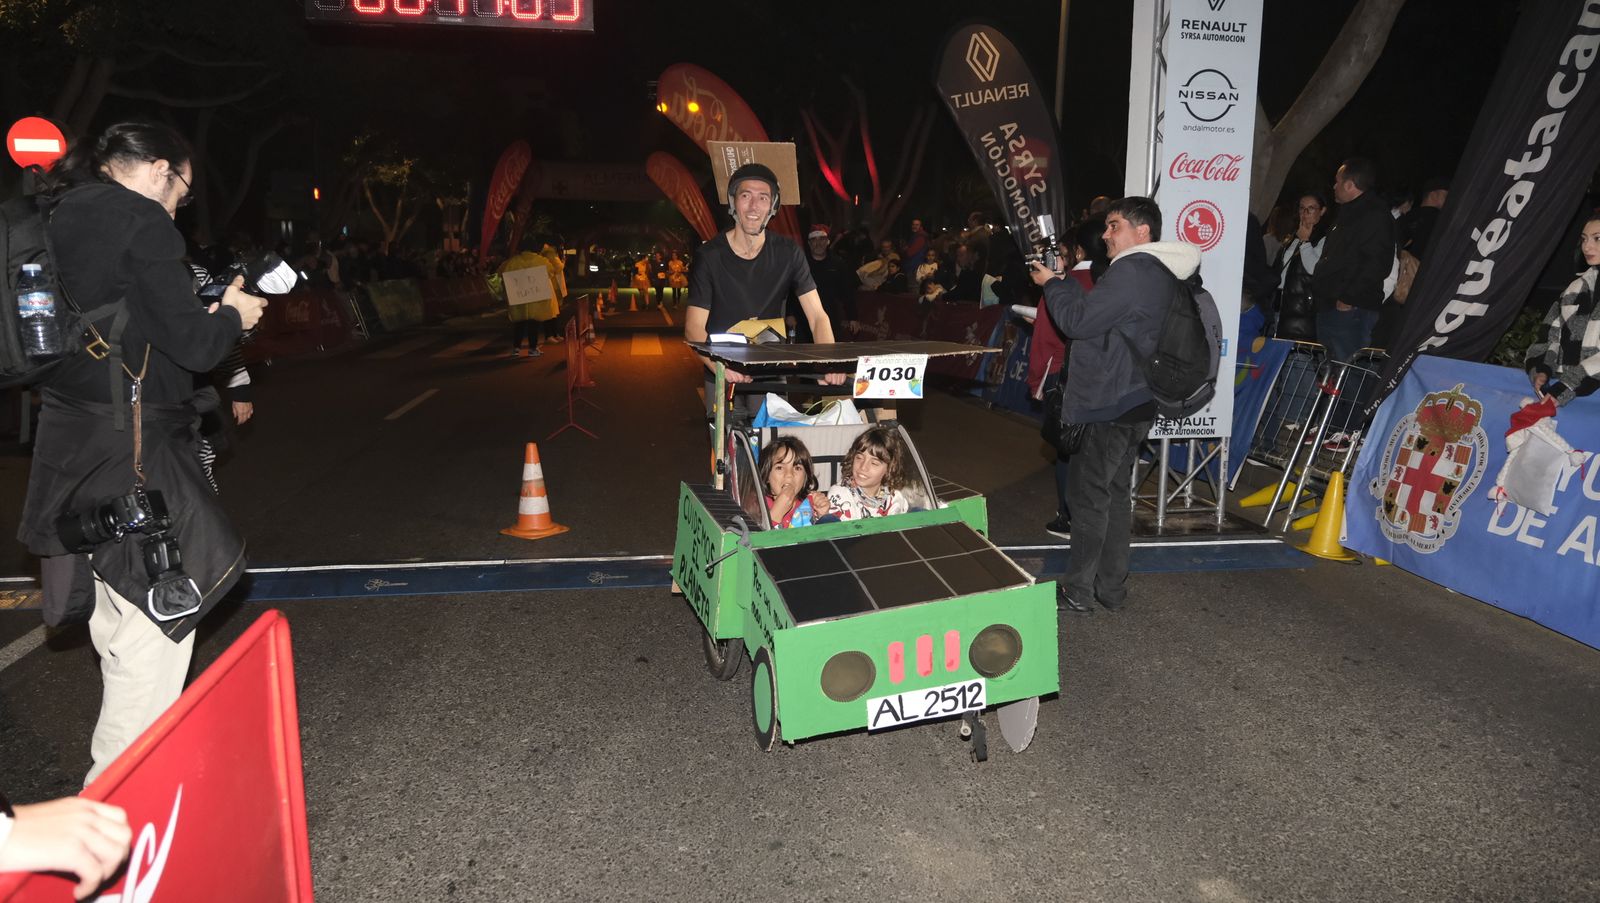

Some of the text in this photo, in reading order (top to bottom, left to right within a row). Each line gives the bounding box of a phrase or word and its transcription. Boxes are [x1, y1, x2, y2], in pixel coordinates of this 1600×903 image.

[1181, 19, 1247, 33] RENAULT
[1180, 32, 1246, 43] SYRSA AUTOMOCION
[1178, 89, 1240, 102] NISSAN
[1182, 124, 1236, 134] andalmotor.es
[1169, 151, 1245, 182] Coca-Cola
[866, 366, 916, 381] 1030
[1155, 417, 1217, 427] RENAULT
[1175, 428, 1216, 436] AUTOMOCION
[683, 495, 716, 580] CUIDEMOS
[1487, 500, 1600, 567] DE A
[691, 538, 700, 571] EL
[679, 554, 710, 626] PLANETA
[873, 682, 983, 728] AL 2512
